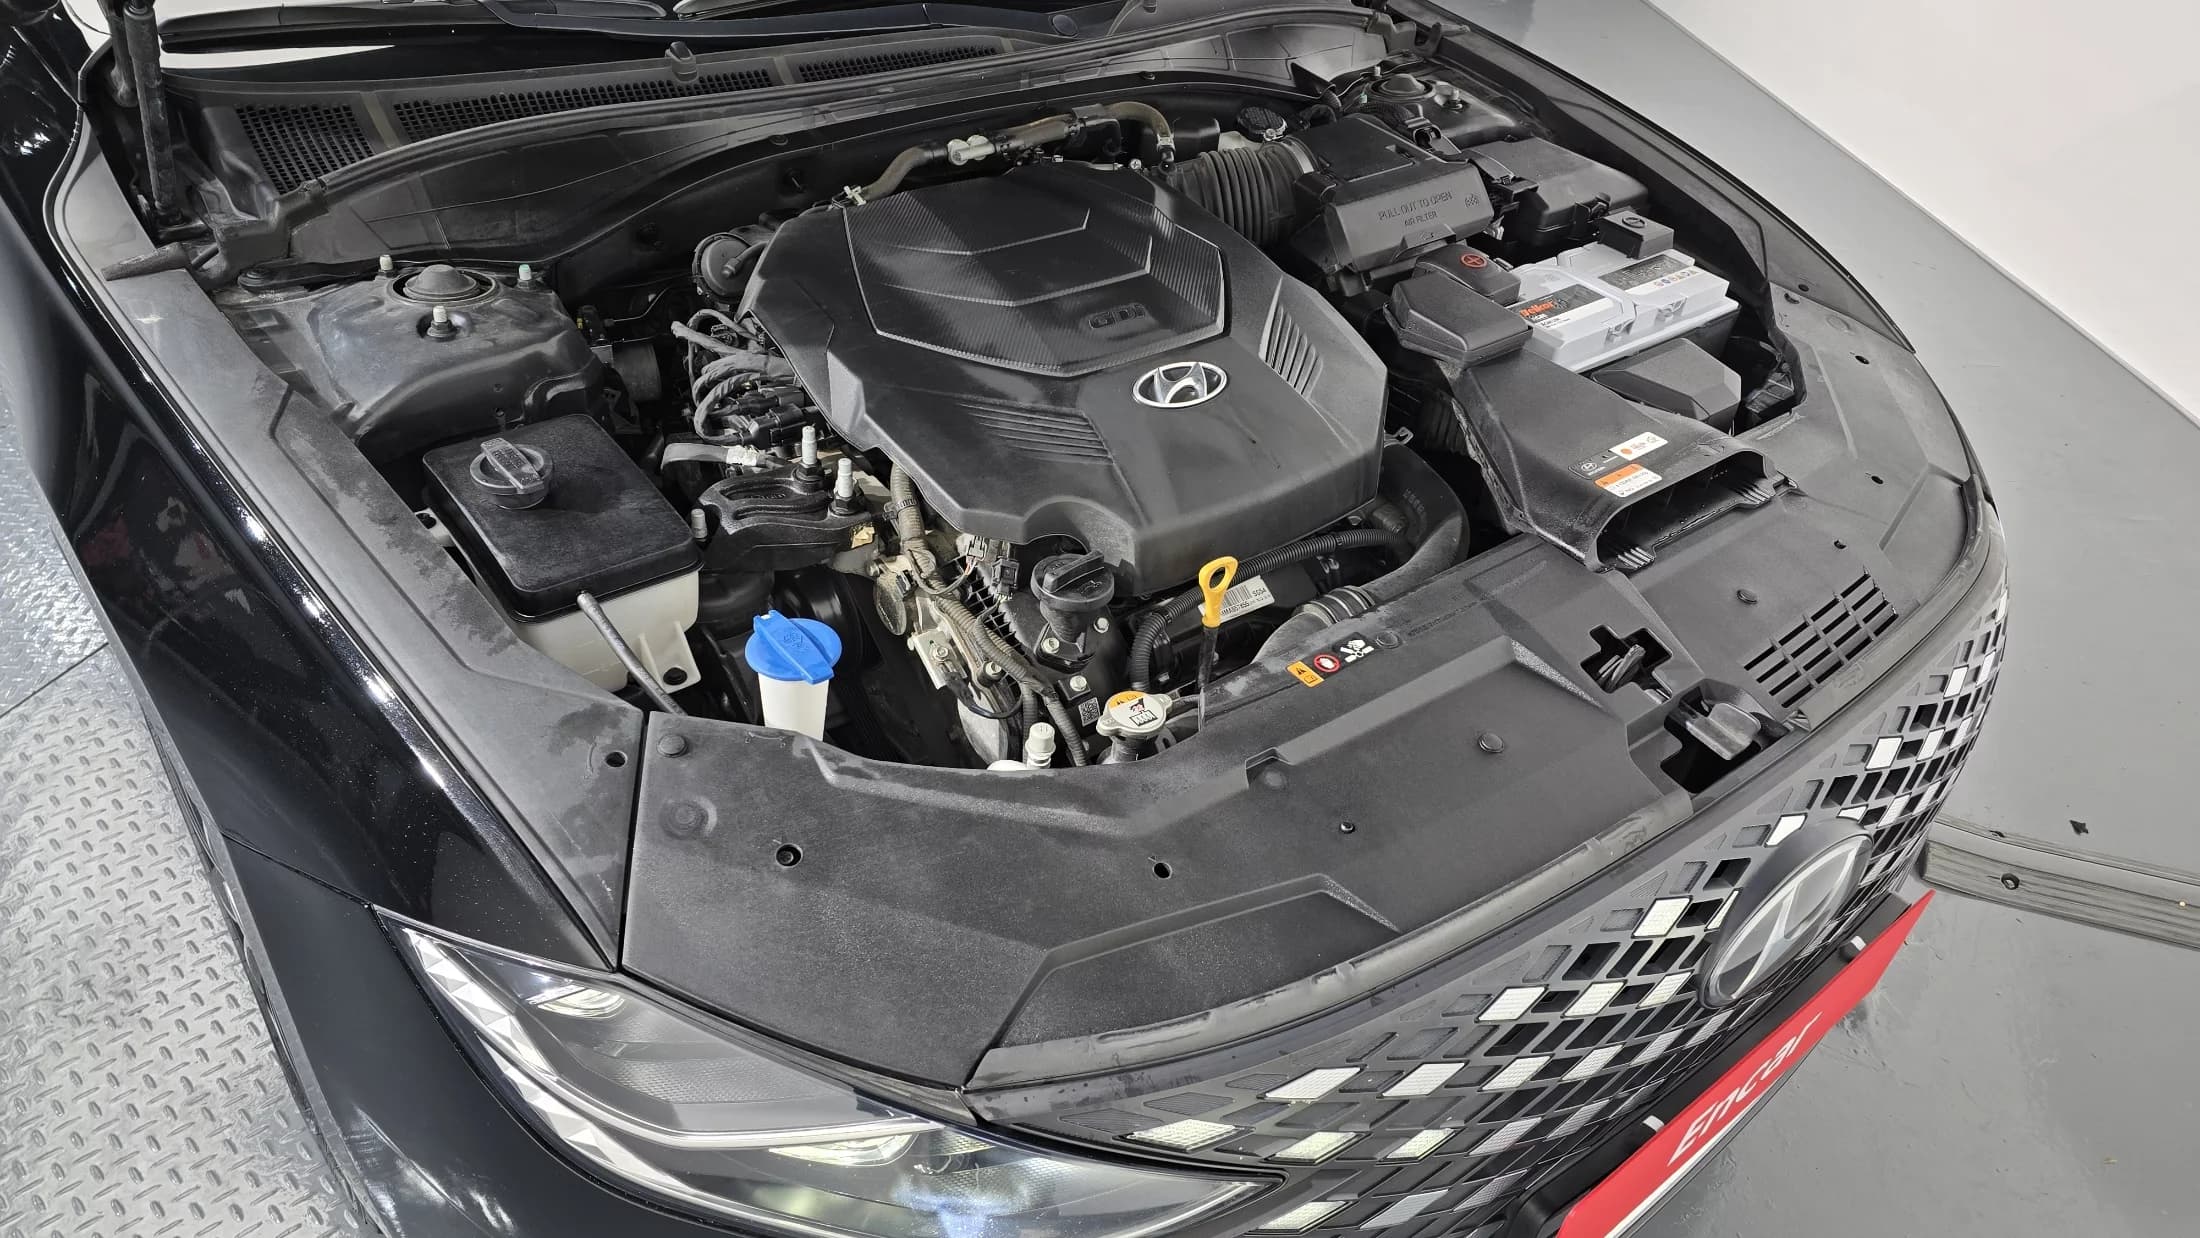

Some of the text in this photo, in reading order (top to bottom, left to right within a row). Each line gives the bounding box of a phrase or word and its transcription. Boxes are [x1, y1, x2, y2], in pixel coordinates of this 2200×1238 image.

[1378, 191, 1453, 221] PULL OUT TO OPEN
[1404, 210, 1438, 226] AIR FILTER
[1666, 1011, 1823, 1167] Encar
